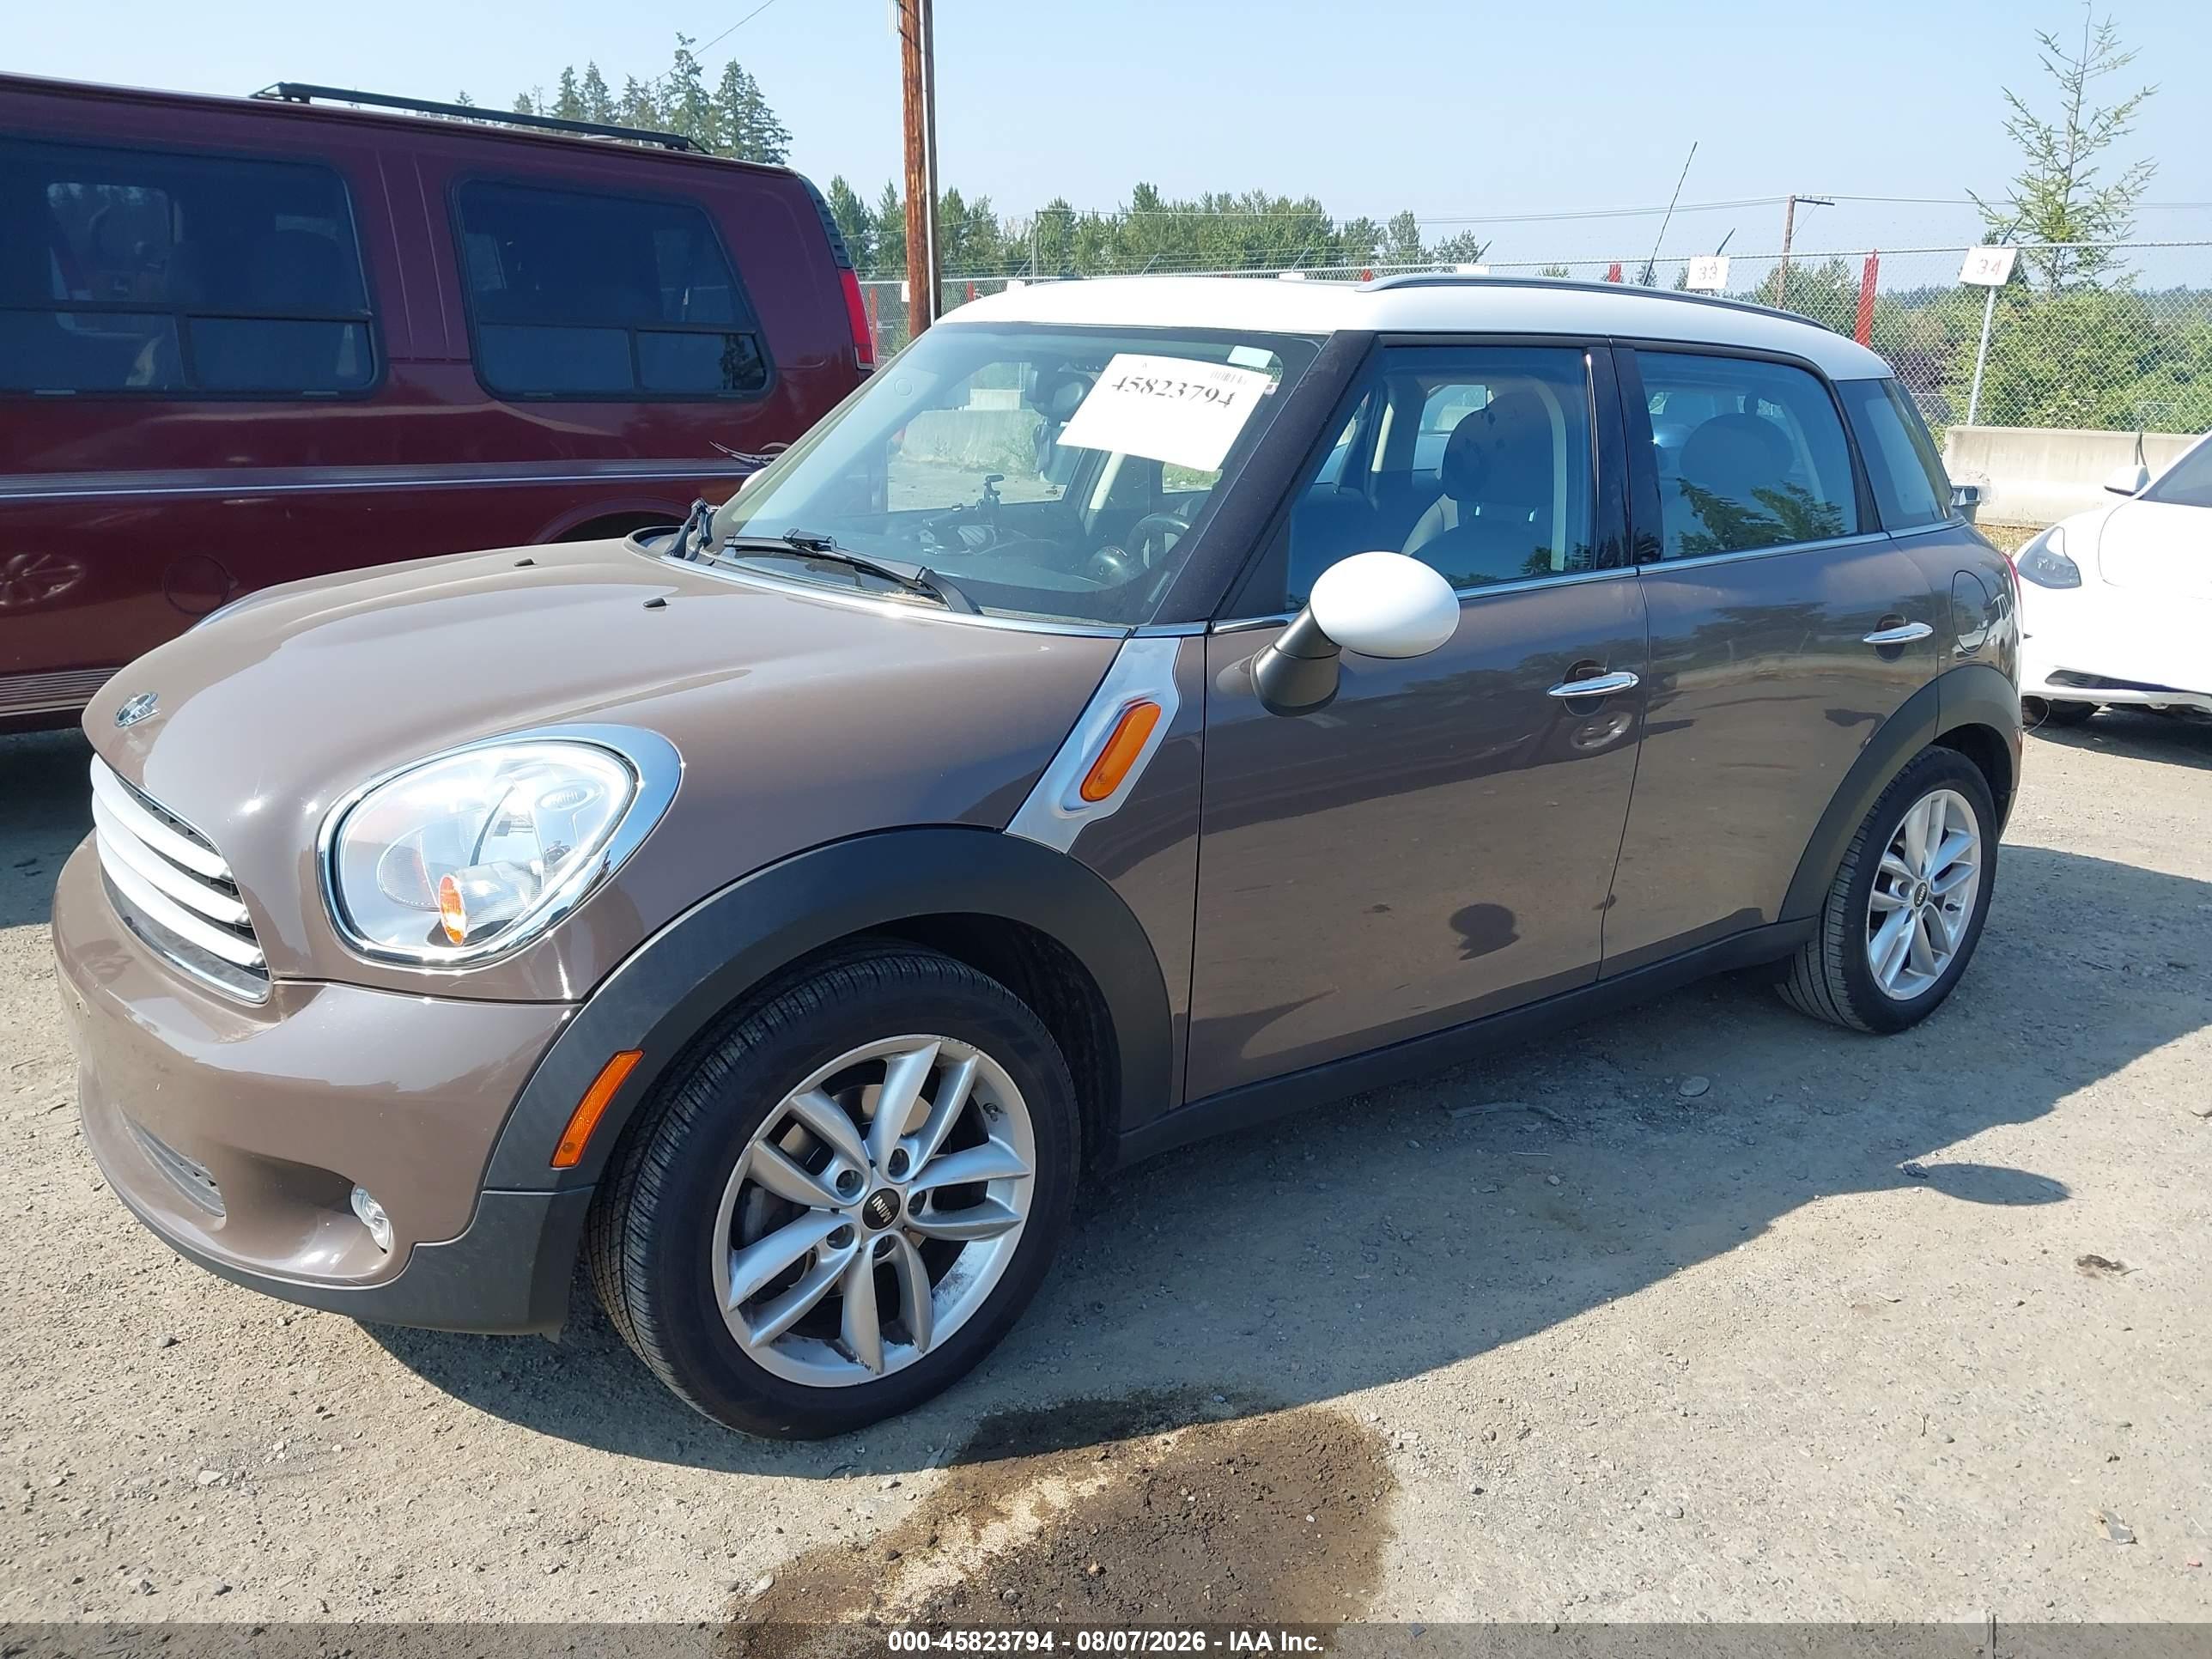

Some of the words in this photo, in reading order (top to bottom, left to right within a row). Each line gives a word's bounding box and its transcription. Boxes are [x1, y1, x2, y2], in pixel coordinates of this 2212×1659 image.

[1977, 258, 2002, 276] 34
[1111, 375, 1237, 409] 45823794
[871, 1194, 893, 1224] MINI
